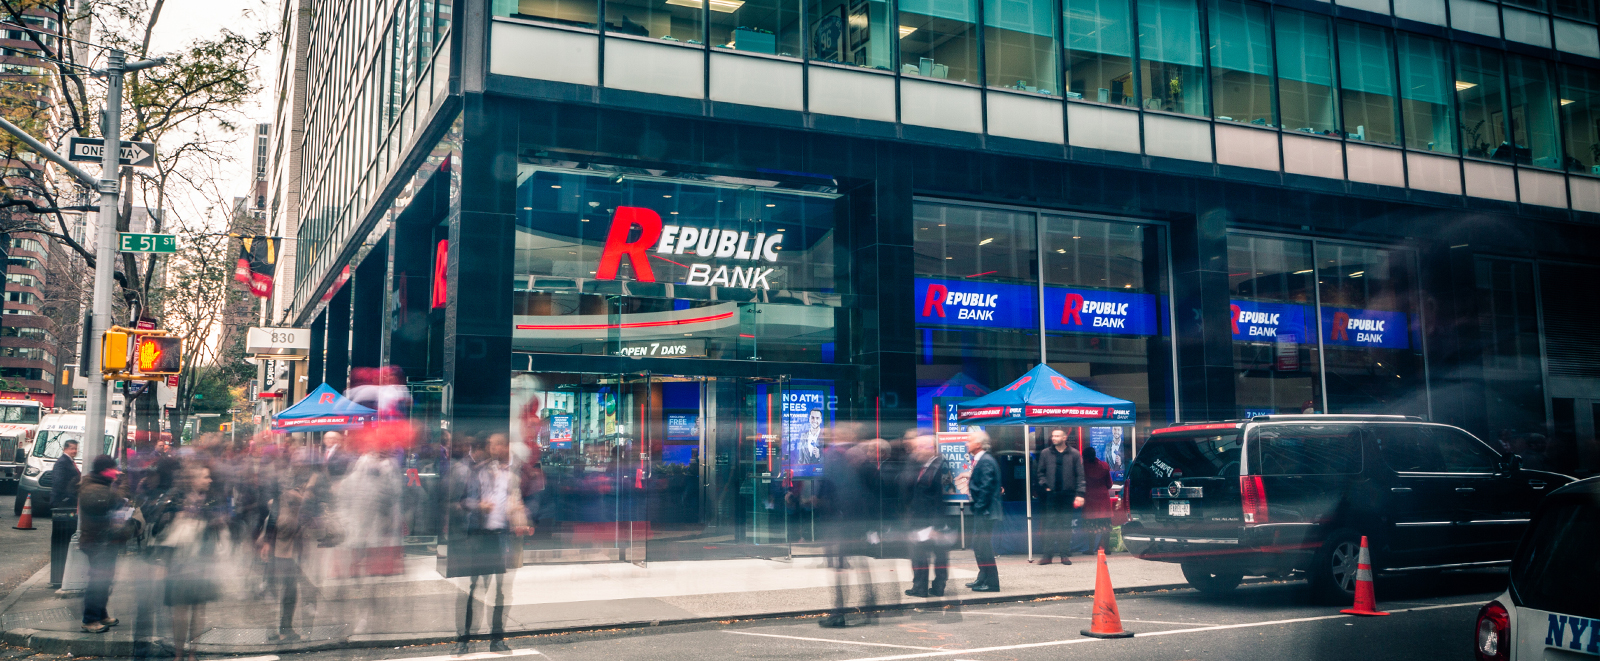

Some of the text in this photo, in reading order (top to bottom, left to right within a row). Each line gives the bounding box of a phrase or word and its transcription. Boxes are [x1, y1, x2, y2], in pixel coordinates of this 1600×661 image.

[122, 236, 175, 251] E 51 ST
[595, 206, 783, 282] REPUBLIC
[686, 263, 774, 290] BANK
[922, 284, 998, 318] REPUBLIC
[958, 308, 994, 321] BANK
[1061, 293, 1128, 326] REPUBLIC
[1092, 316, 1126, 328] BANK
[1330, 312, 1386, 340] REPUBLIC
[270, 332, 295, 344] 830
[1249, 326, 1278, 338] BANK
[1356, 332, 1382, 343] BANK
[621, 342, 686, 356] OPEN 7 DAYS
[318, 392, 336, 404] R
[782, 394, 798, 402] NO
[799, 394, 818, 402] ATM
[782, 404, 806, 412] FEES
